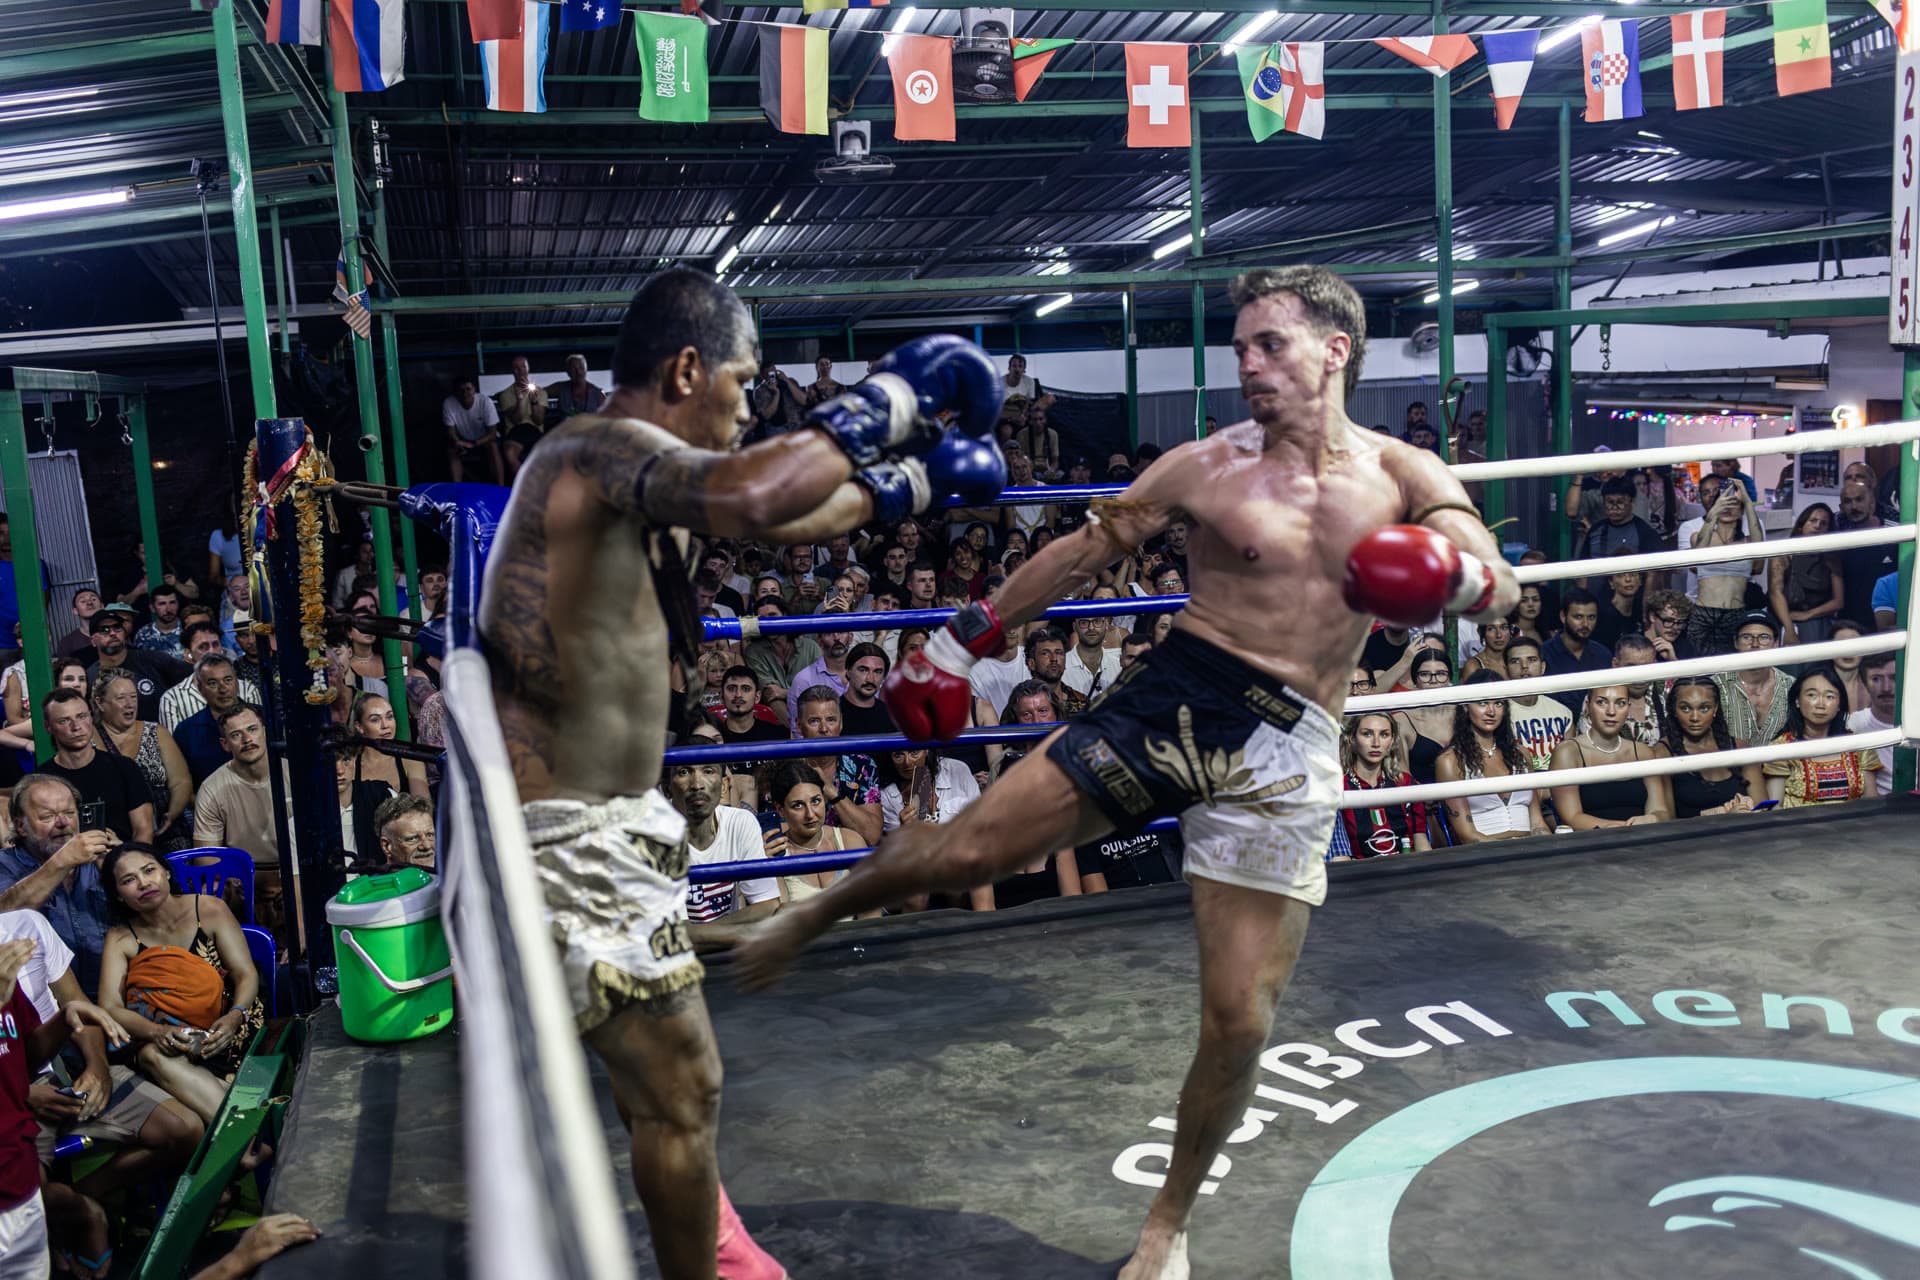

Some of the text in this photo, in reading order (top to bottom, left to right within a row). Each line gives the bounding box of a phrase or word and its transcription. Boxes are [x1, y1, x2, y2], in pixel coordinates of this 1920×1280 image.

[1903, 66, 1915, 122] 2
[1901, 133, 1913, 189] 3
[1900, 206, 1911, 260] 4
[1898, 277, 1910, 330] 5
